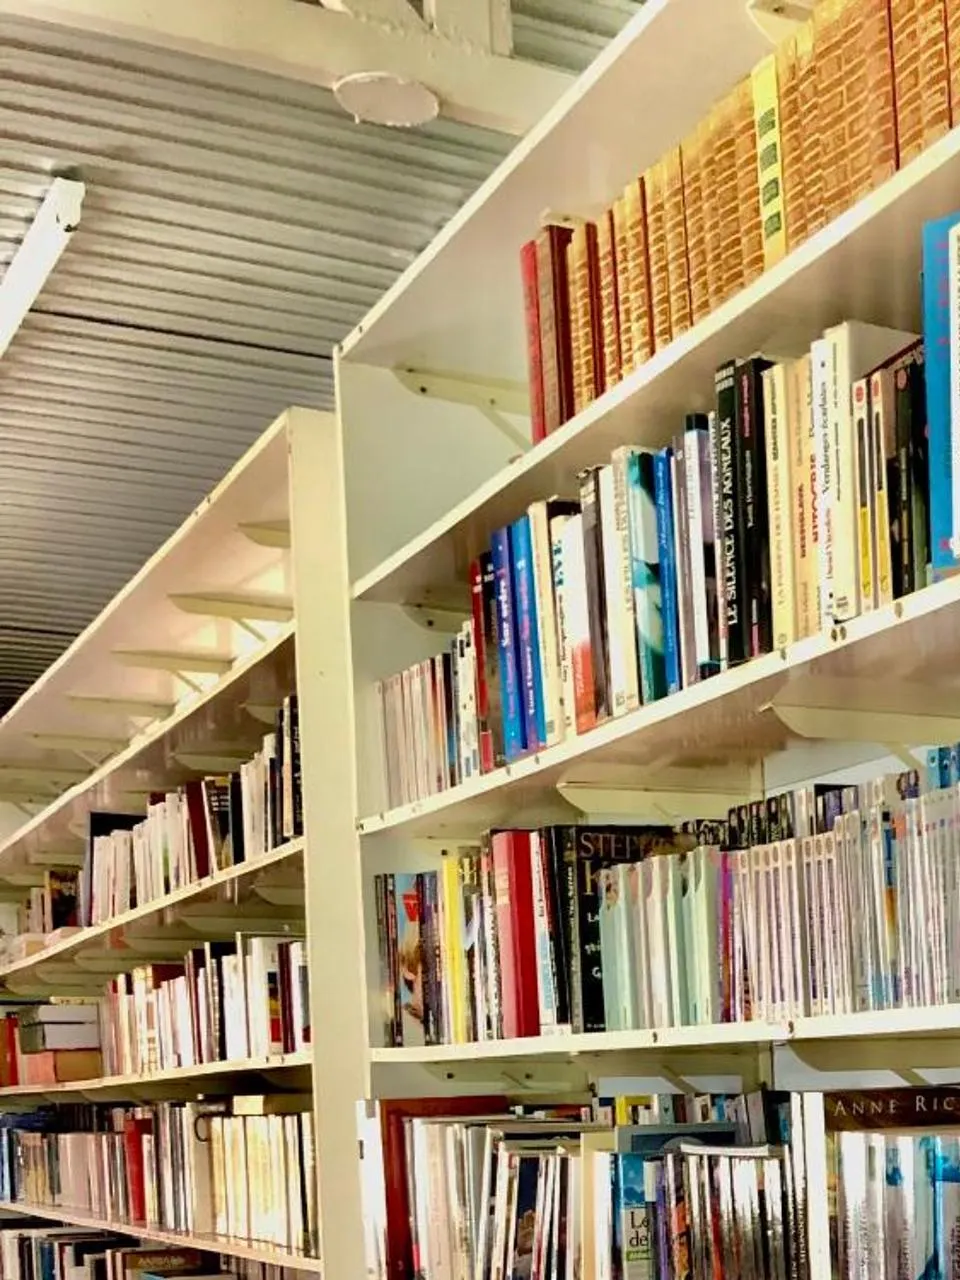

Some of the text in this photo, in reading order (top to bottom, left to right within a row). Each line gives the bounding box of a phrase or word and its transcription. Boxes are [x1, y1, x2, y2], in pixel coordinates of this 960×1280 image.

[720, 416, 739, 625] LE SILENCE DES AGNEAUX
[498, 579, 512, 648] Sur ordre
[834, 1099, 901, 1117] ANNE
